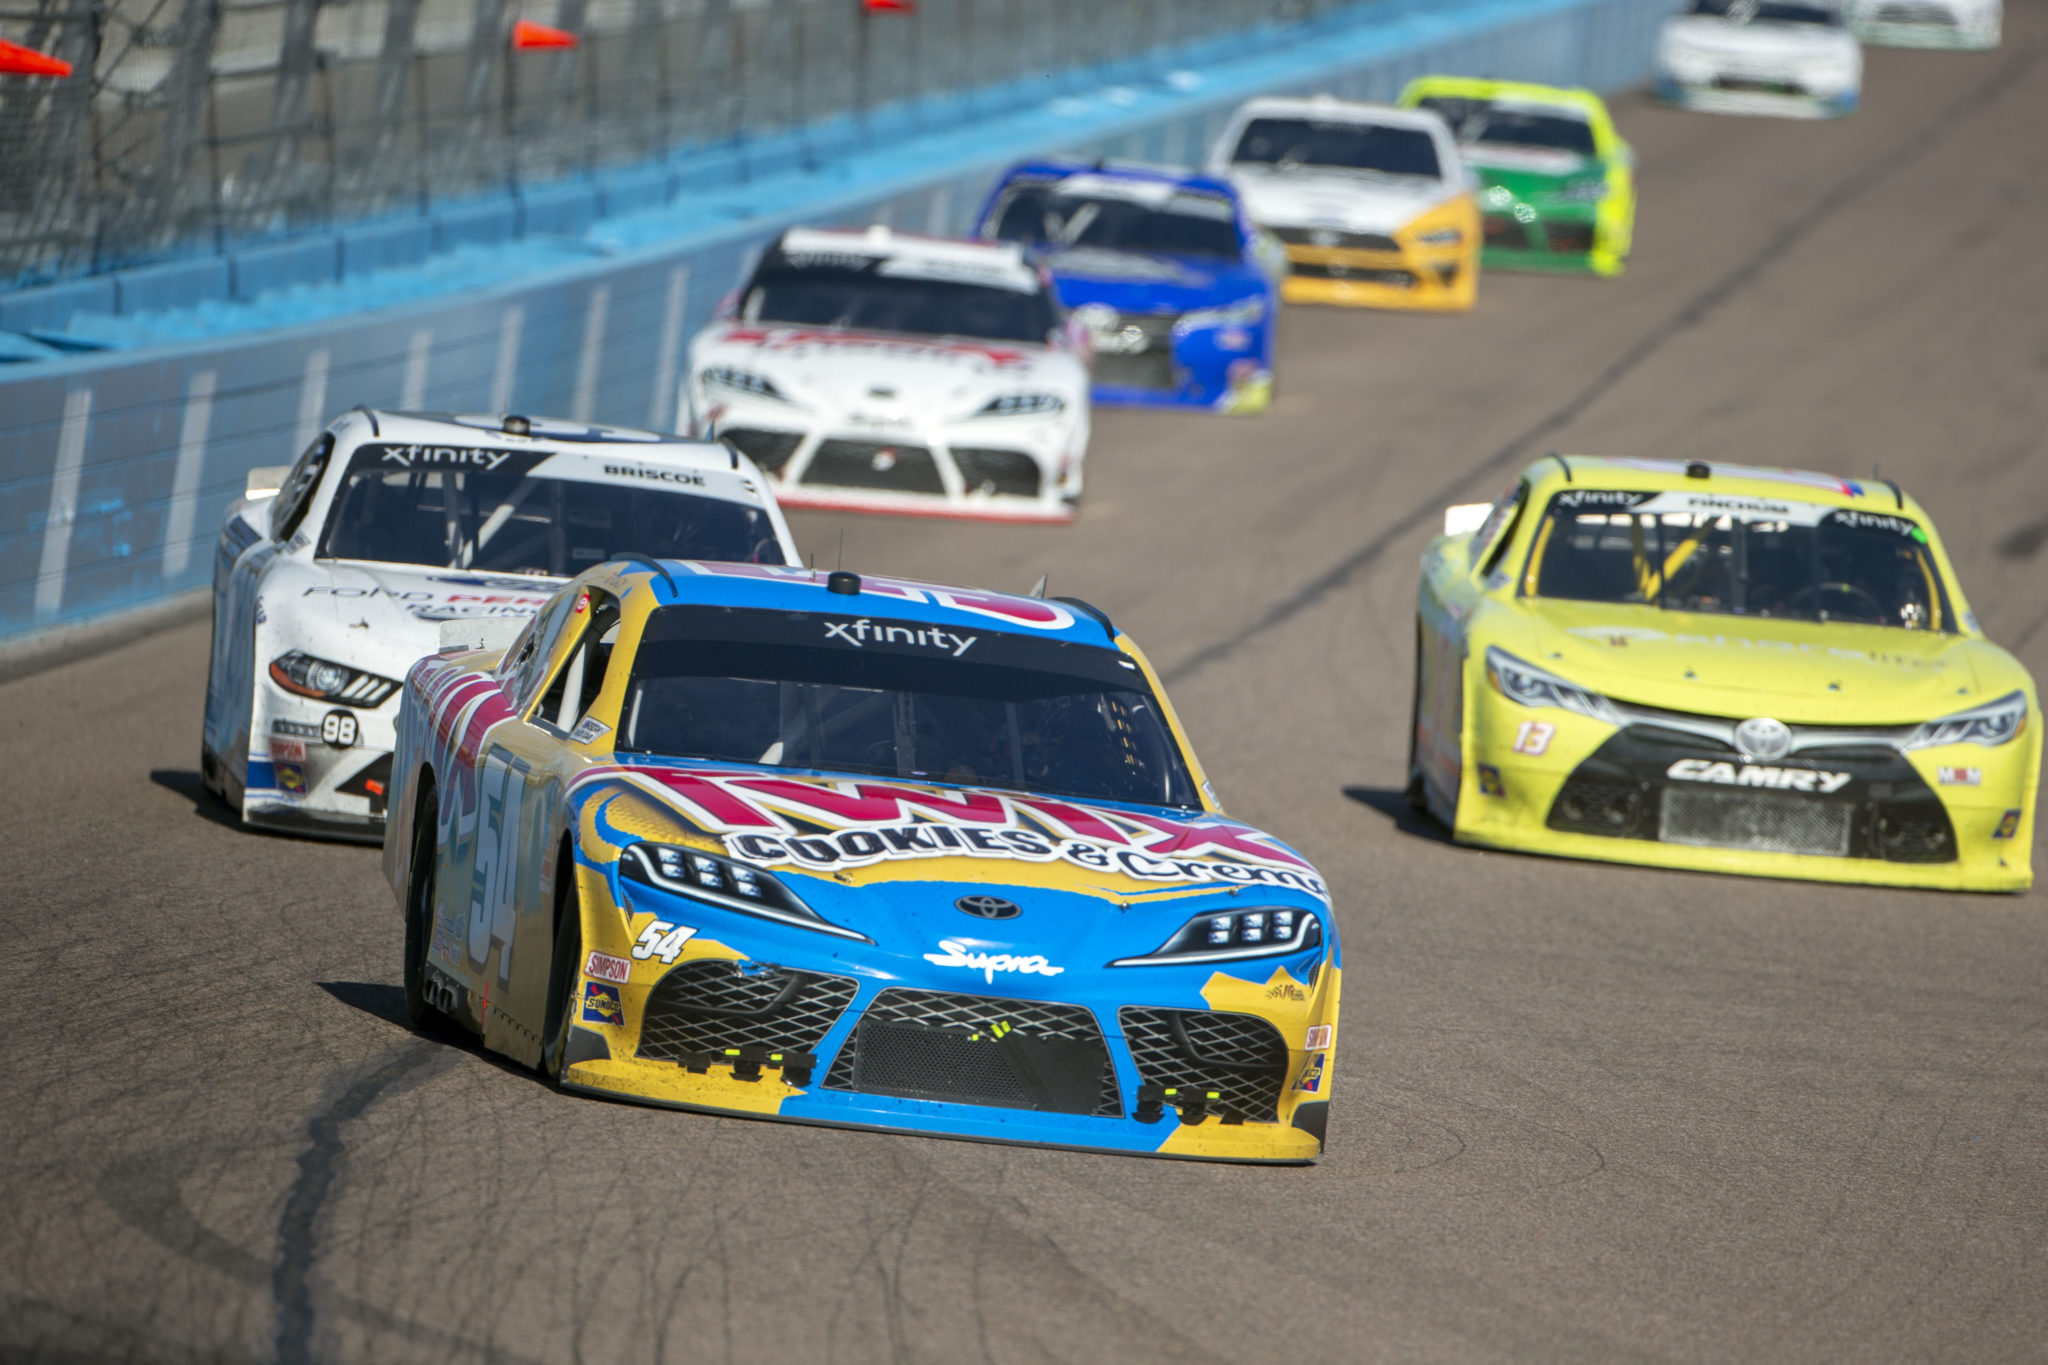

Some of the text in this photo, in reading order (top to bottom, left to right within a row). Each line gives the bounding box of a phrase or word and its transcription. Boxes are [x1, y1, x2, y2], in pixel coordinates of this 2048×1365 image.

[381, 446, 511, 471] xfinity
[604, 464, 706, 487] BRISCOE
[1687, 496, 1790, 515] FINCHUM
[1833, 510, 1914, 536] xfinity
[823, 617, 979, 658] xfinity
[323, 713, 357, 745] 98
[1511, 720, 1557, 757] 13
[1665, 758, 1853, 793] CAMRY
[735, 822, 1044, 864] COOKIES
[1068, 840, 1110, 868] &
[631, 919, 699, 964] 54
[588, 954, 628, 981] SIMPSON
[923, 939, 1065, 985] Supra
